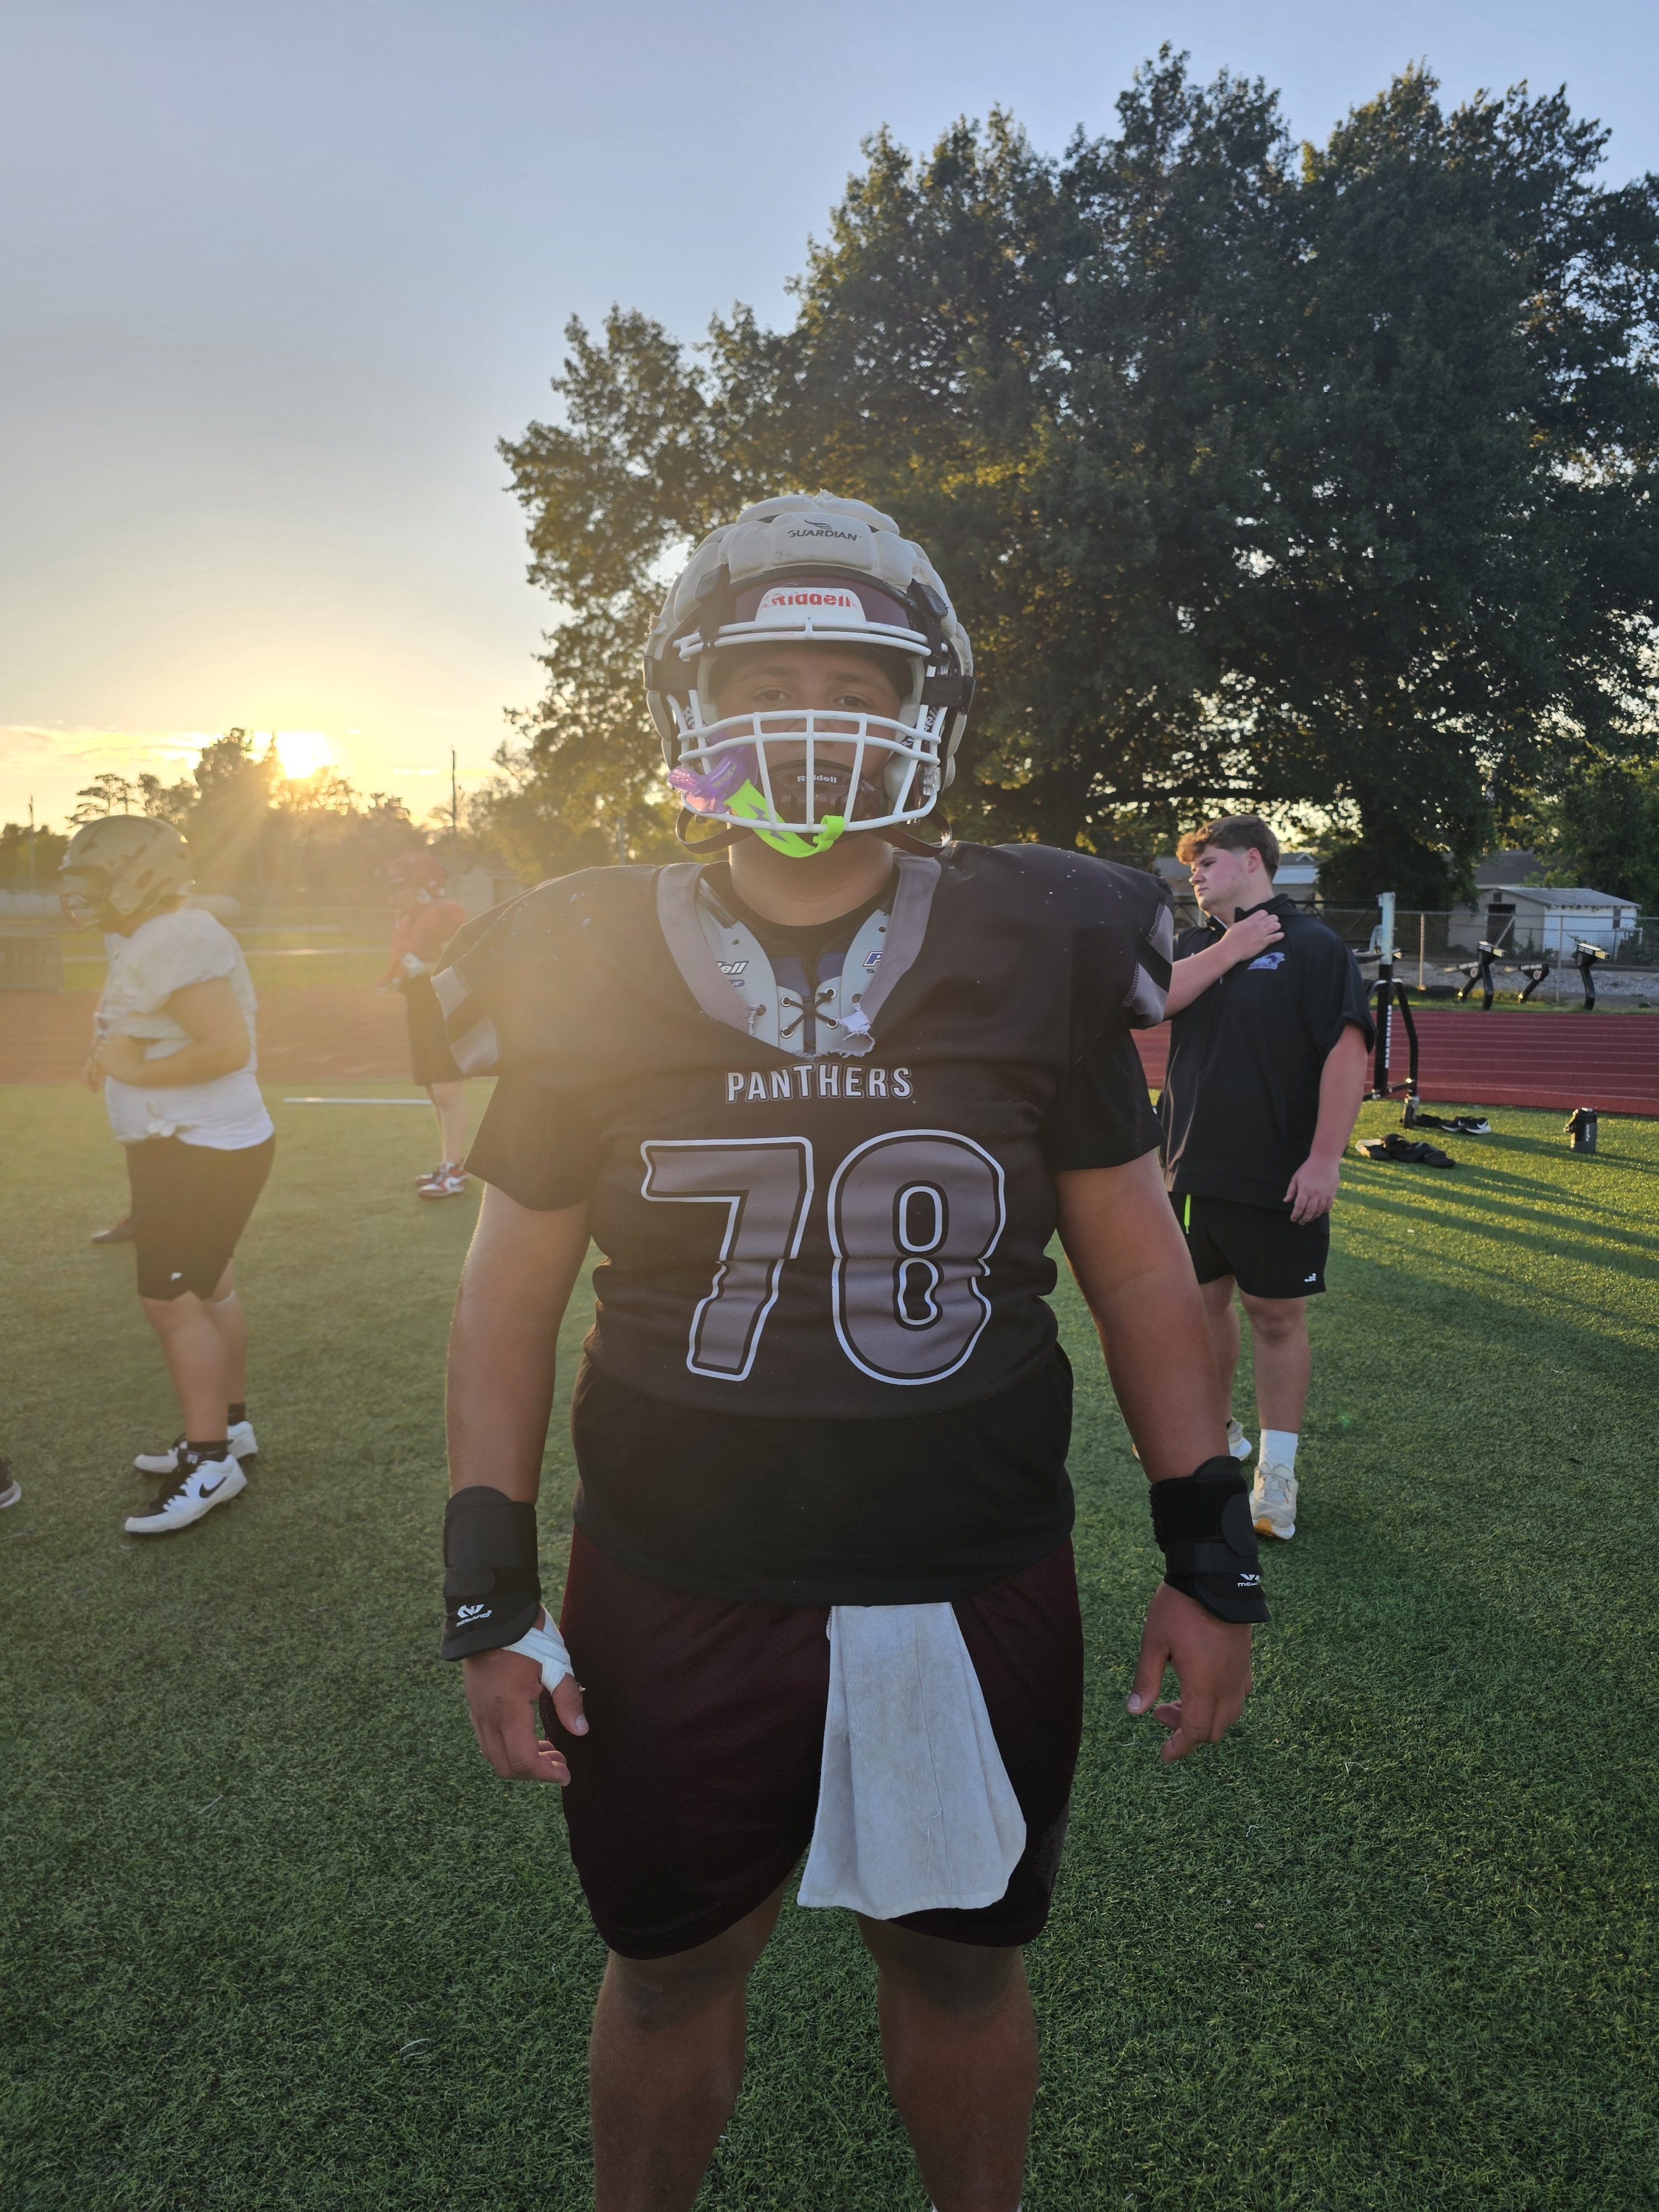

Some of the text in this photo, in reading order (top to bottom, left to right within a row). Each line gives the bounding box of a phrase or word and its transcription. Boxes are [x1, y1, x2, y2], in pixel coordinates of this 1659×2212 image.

[787, 529, 857, 541] GUARDIAN
[726, 1062, 914, 1103] PANTHERS
[640, 1129, 1006, 1385] 78
